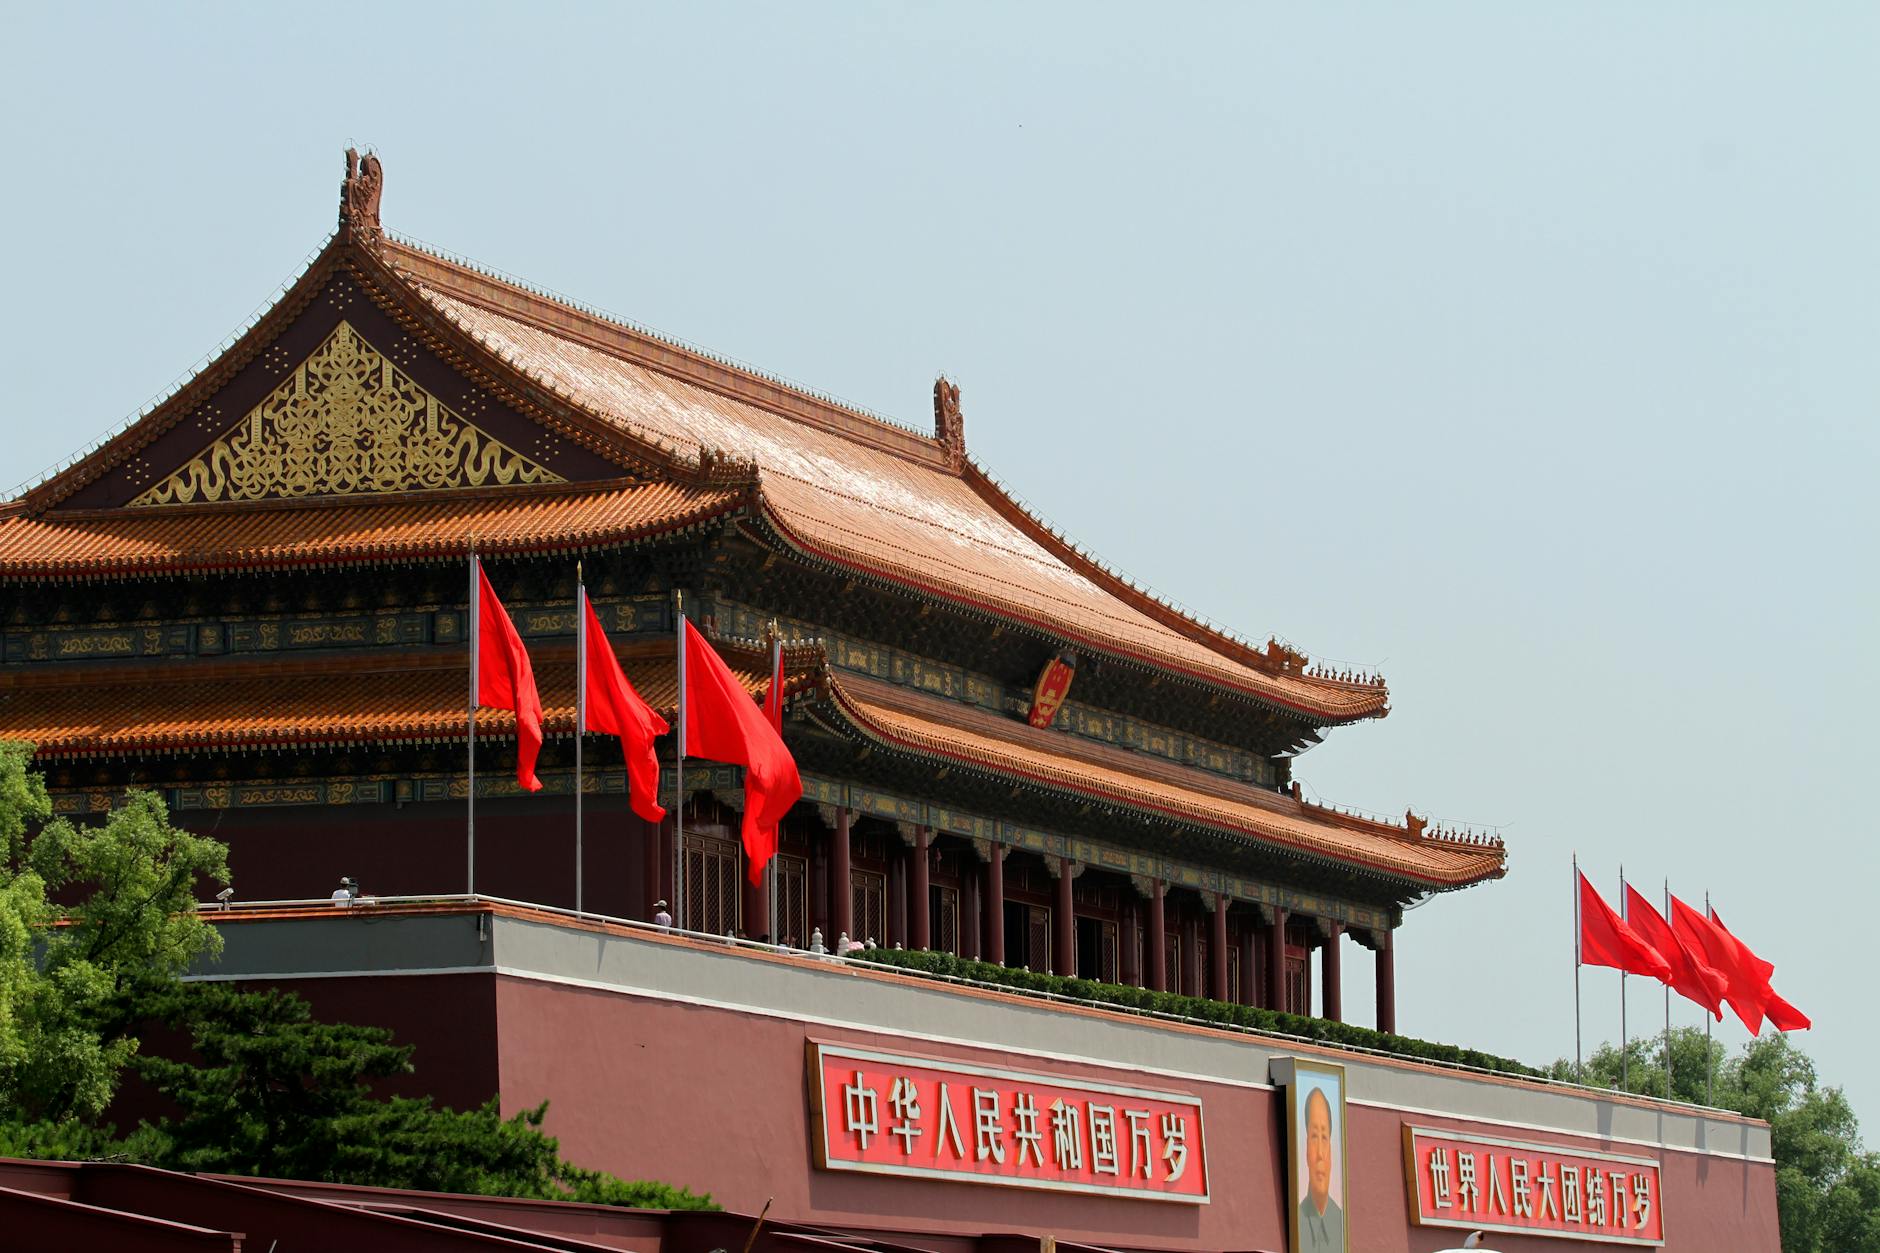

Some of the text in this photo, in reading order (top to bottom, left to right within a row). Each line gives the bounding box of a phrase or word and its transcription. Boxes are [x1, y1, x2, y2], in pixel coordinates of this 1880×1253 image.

[844, 1071, 1189, 1182] 中华人民共和国万岁
[1430, 1147, 1651, 1230] 世界人民大团结万岁
